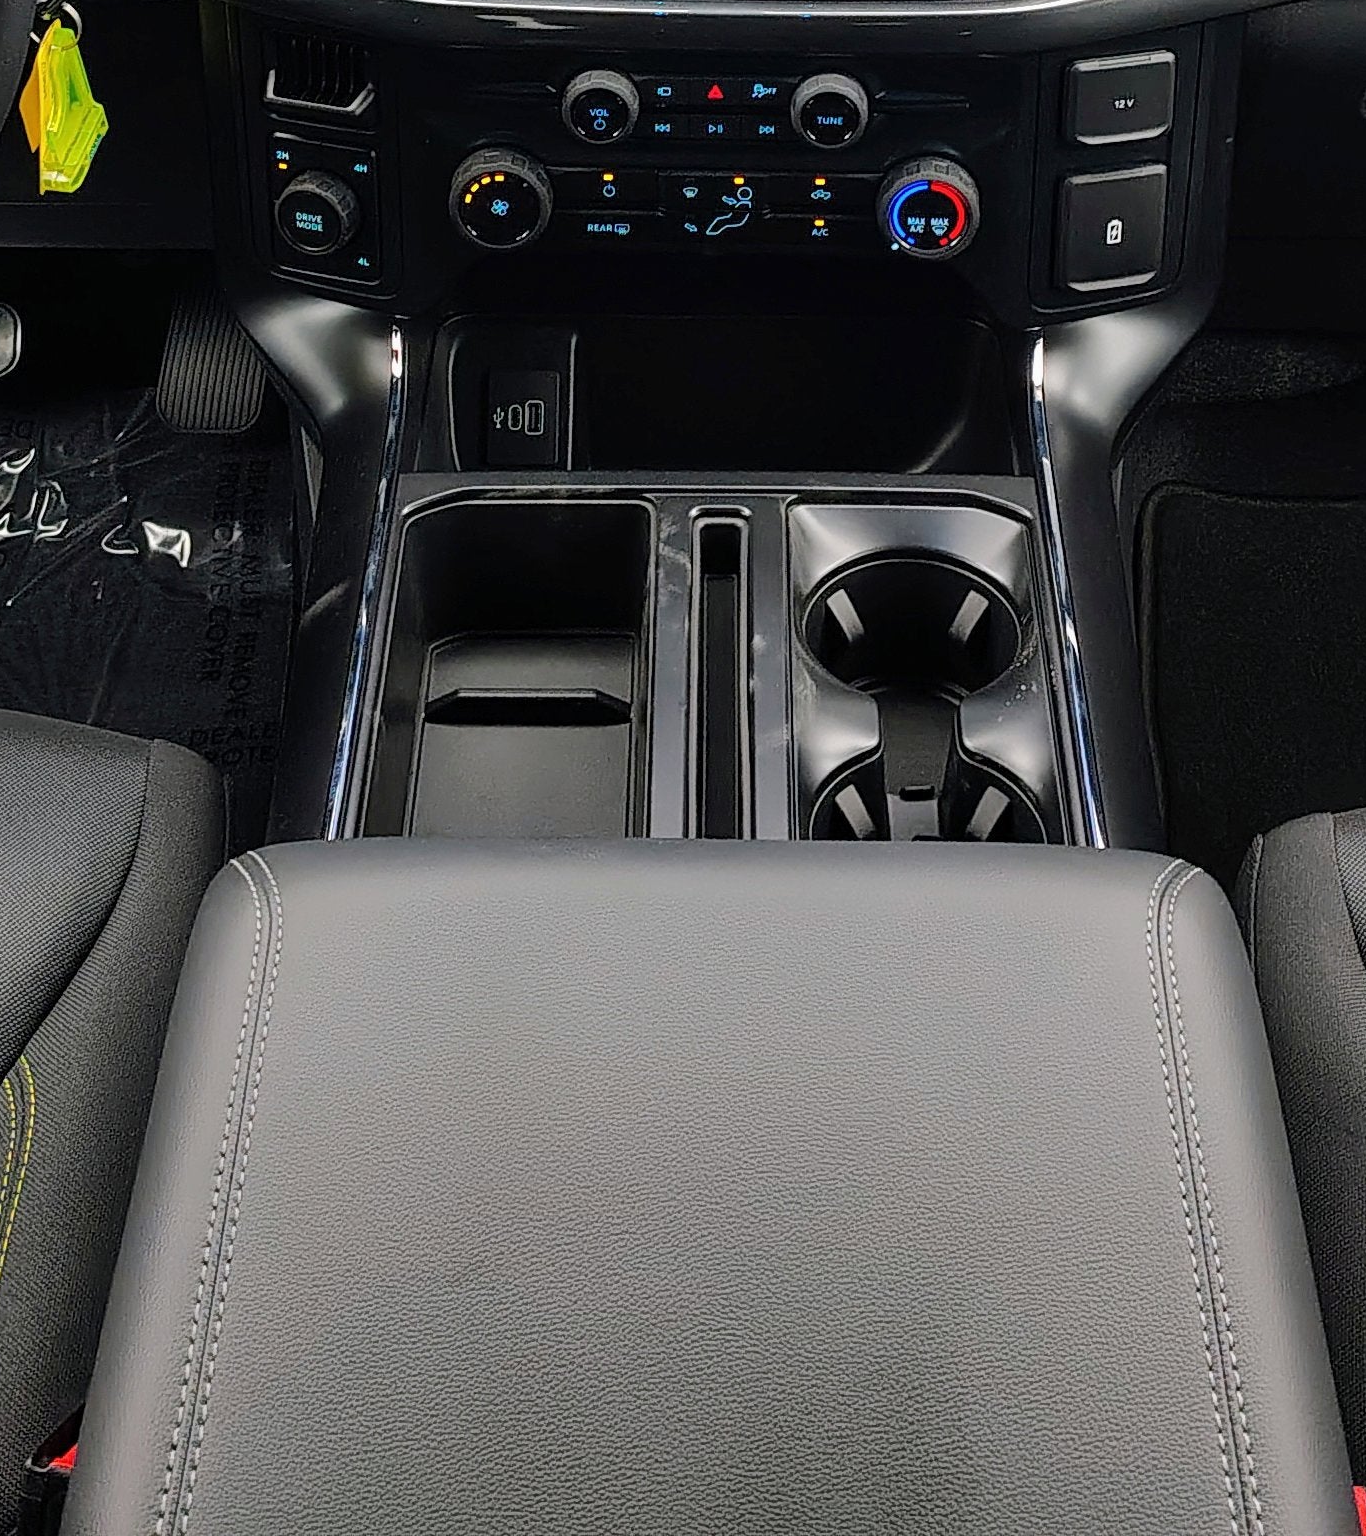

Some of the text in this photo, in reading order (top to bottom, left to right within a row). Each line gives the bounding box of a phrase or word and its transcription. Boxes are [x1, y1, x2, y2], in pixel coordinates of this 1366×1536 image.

[1114, 98, 1135, 109] 12 V
[588, 107, 610, 117] VOL
[816, 115, 844, 126] TUNE
[276, 150, 290, 160] 2H
[354, 163, 368, 173] 4H
[295, 211, 323, 224] DRIVE
[907, 216, 926, 225] MAX
[930, 216, 950, 226] MAX
[296, 221, 324, 232] MODE
[587, 224, 613, 233] REAR
[811, 228, 830, 238] A/C
[357, 257, 370, 267] 4L
